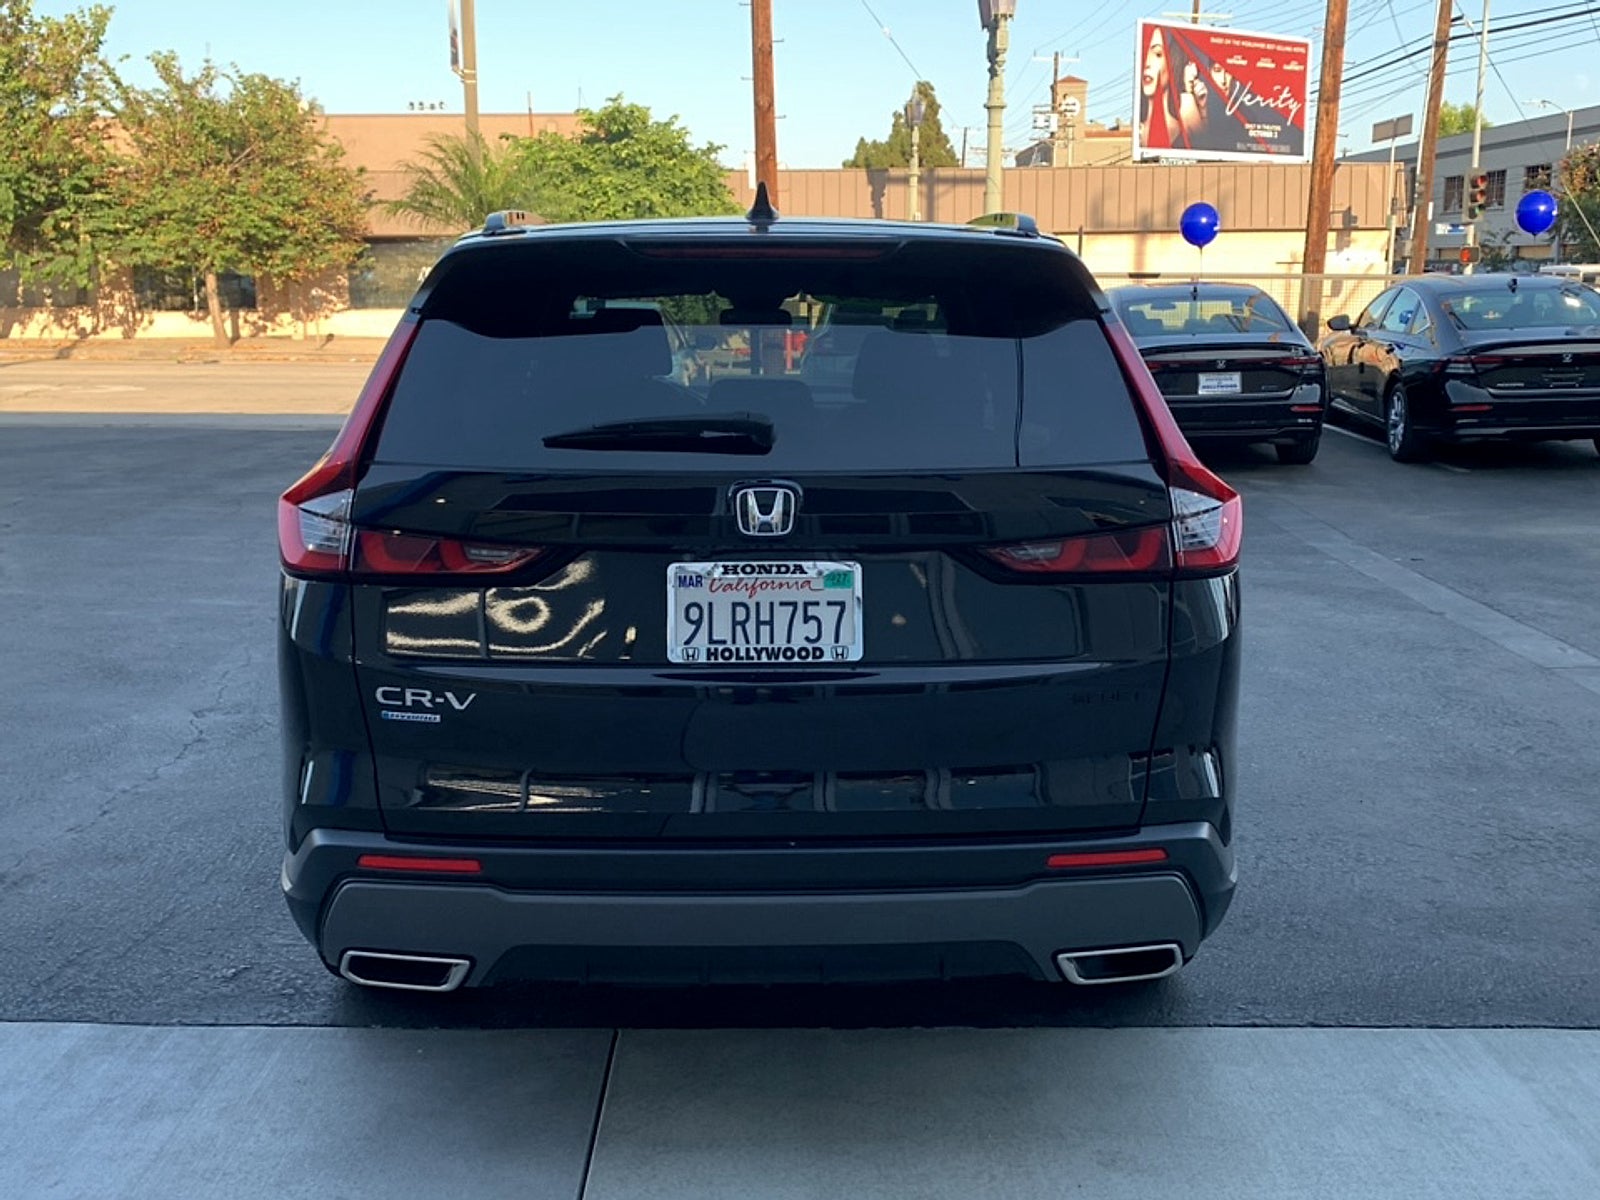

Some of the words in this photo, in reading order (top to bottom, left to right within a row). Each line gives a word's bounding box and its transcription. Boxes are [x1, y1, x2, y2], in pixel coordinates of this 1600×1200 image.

[1226, 81, 1302, 126] Verity
[721, 563, 808, 575] HONDA
[678, 574, 703, 588] MAR
[708, 577, 825, 599] California
[683, 601, 847, 646] 9LRH757
[706, 646, 825, 661] HOLLYWOOD
[375, 686, 477, 711] CR-V
